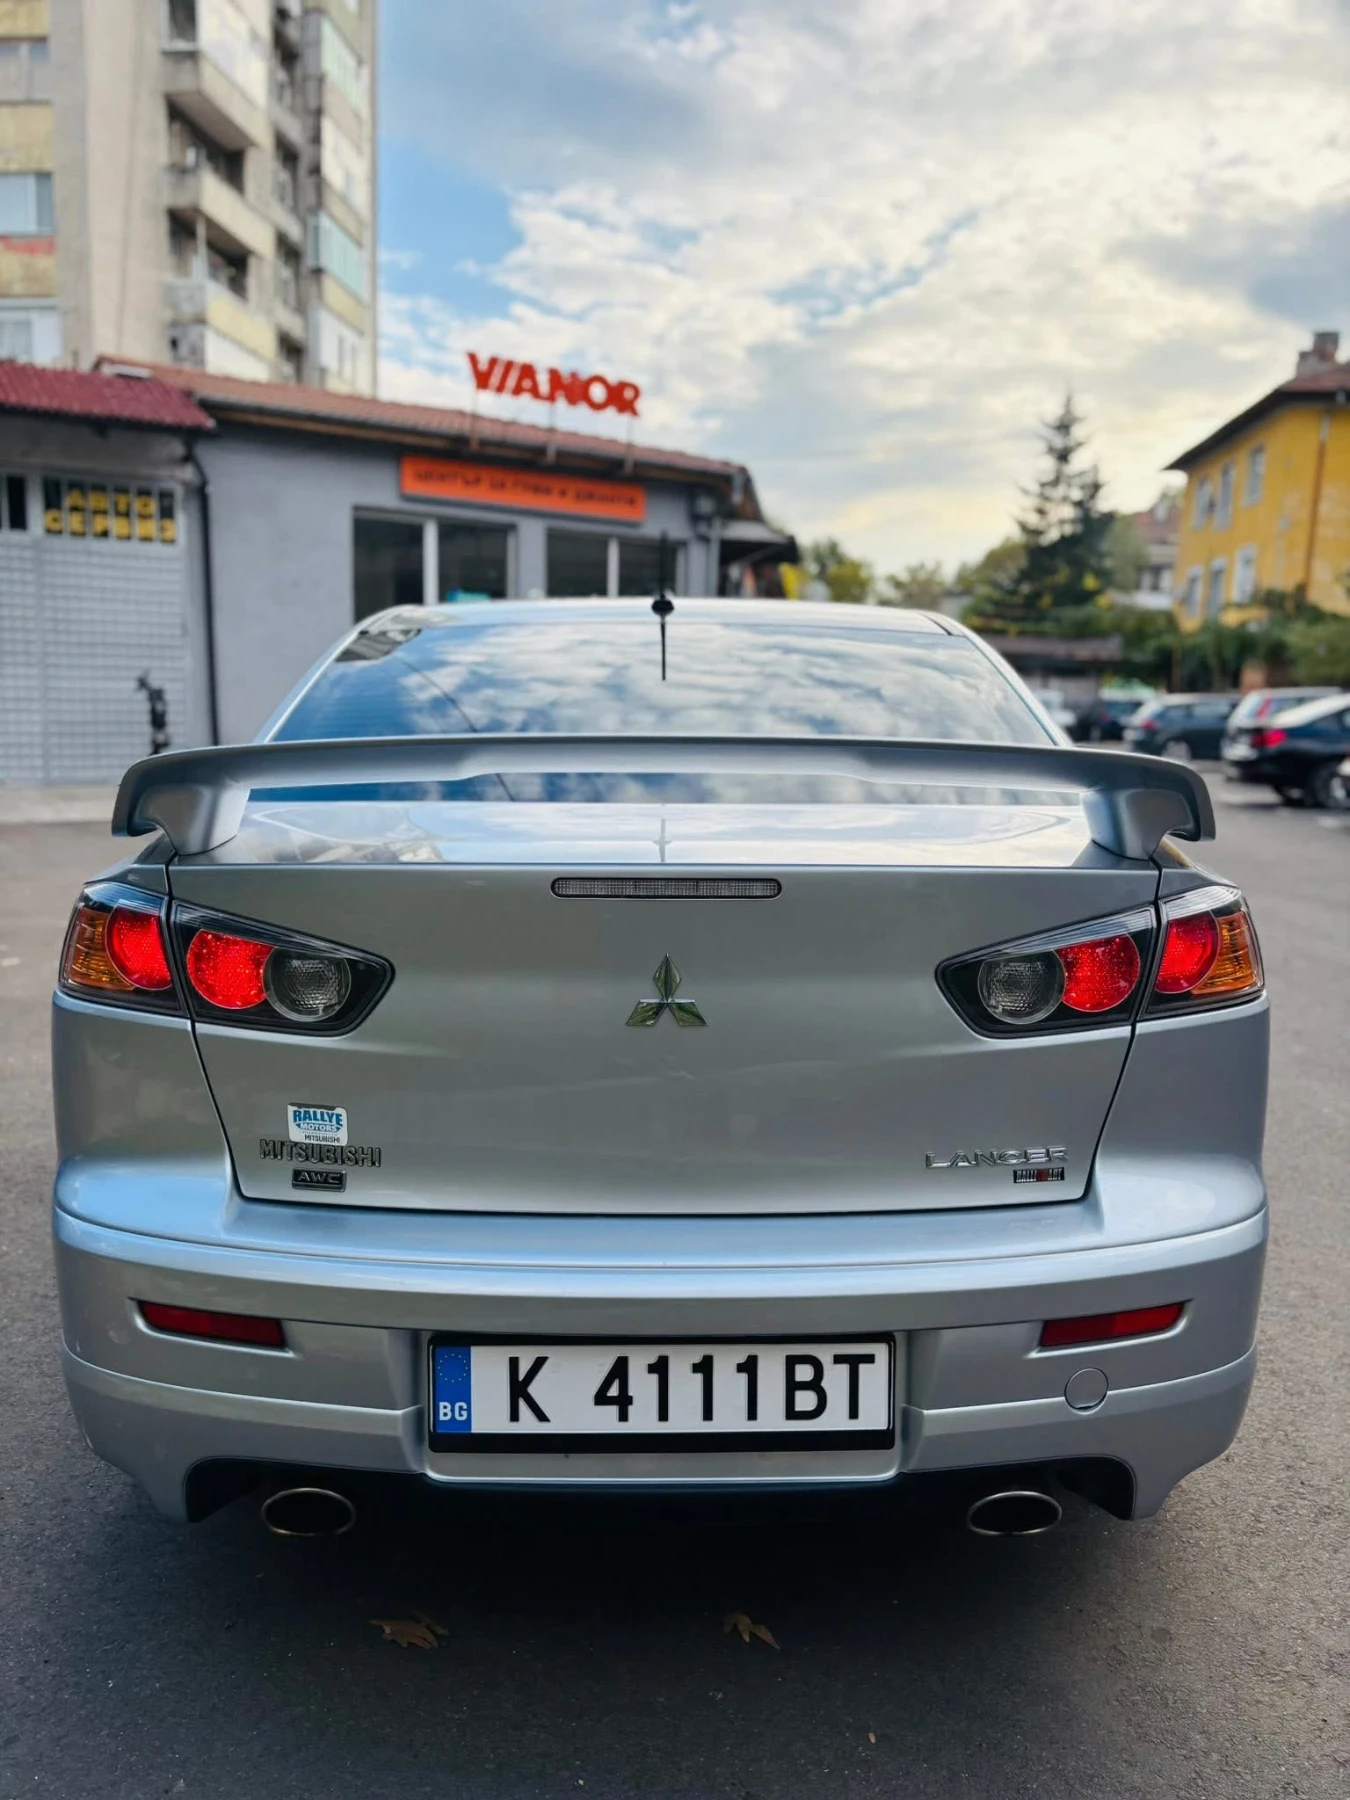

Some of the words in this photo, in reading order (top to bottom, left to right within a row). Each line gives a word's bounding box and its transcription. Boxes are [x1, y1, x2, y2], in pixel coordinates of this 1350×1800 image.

[467, 352, 641, 417] VIANOR
[293, 1109, 343, 1127] RALLYE
[300, 1123, 338, 1133] MOTORS
[259, 1139, 382, 1167] MITSUBISHI
[925, 1146, 1068, 1168] LANCER
[297, 1172, 341, 1184] AWC
[508, 1356, 551, 1423] K
[438, 1401, 468, 1421] BG
